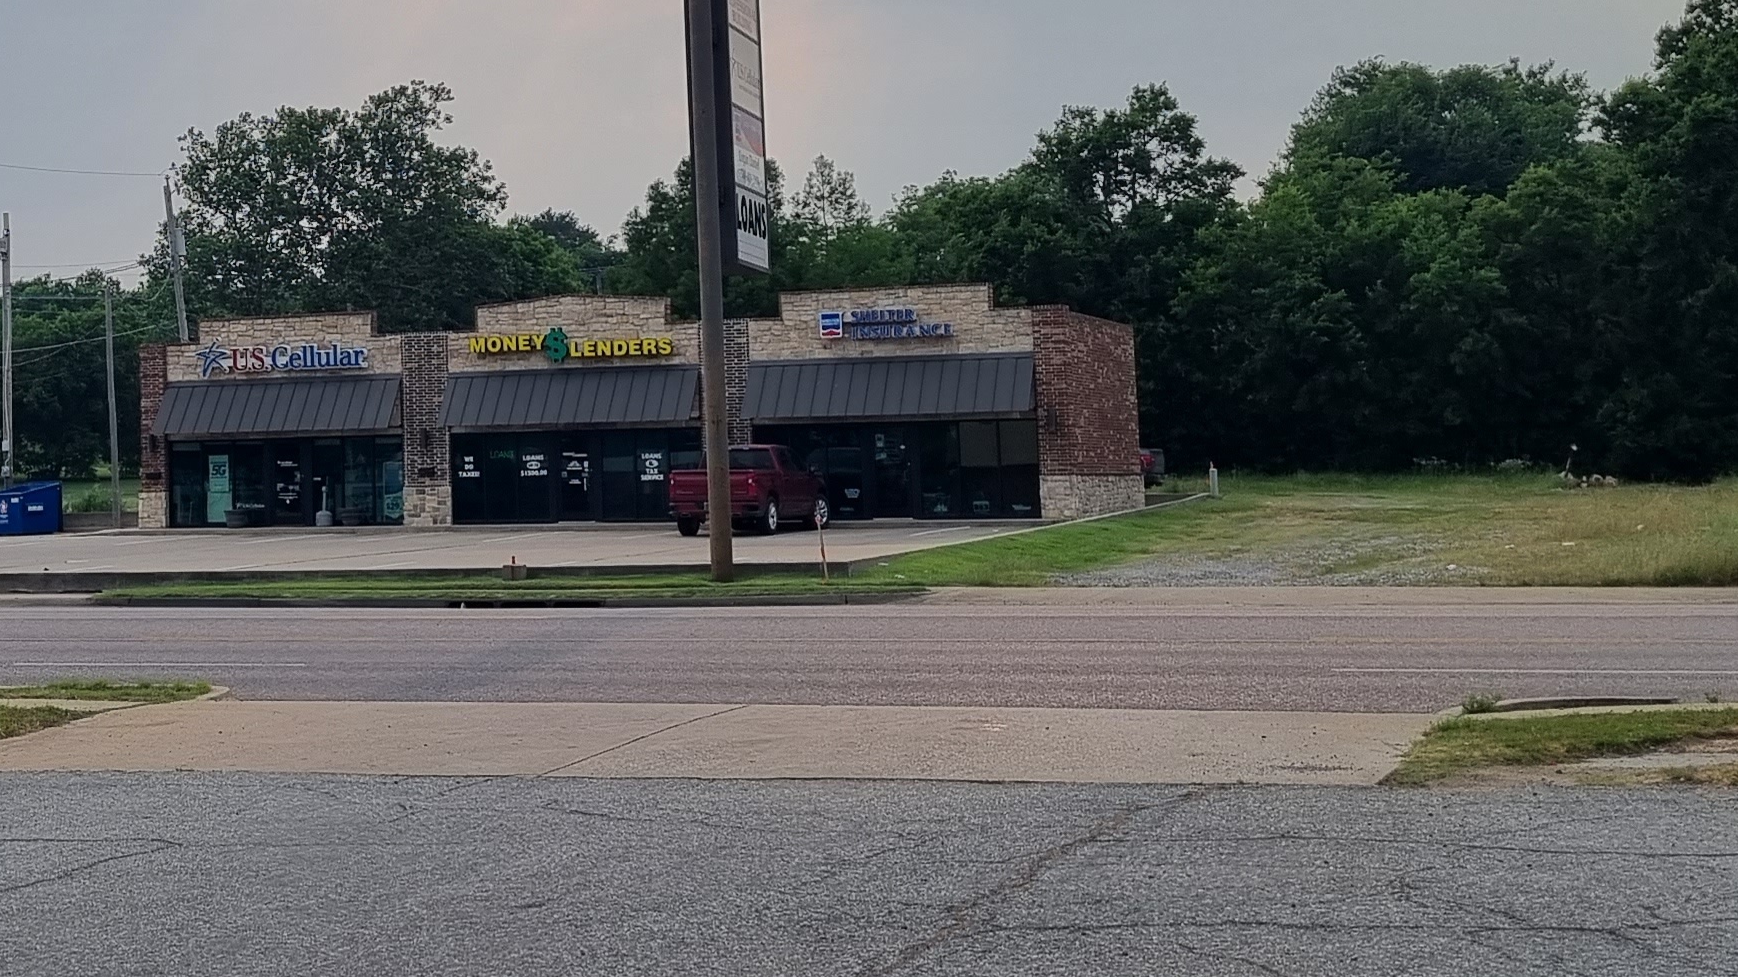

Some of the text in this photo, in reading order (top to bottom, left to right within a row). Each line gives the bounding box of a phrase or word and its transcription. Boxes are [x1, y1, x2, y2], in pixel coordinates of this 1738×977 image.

[736, 195, 766, 239] LOANS
[850, 309, 915, 322] SHELTER
[851, 324, 953, 340] INSURANCE
[469, 335, 546, 353] MONEY
[570, 338, 672, 357] LENDERS
[271, 343, 367, 369] Cellular
[211, 465, 226, 475] 5G
